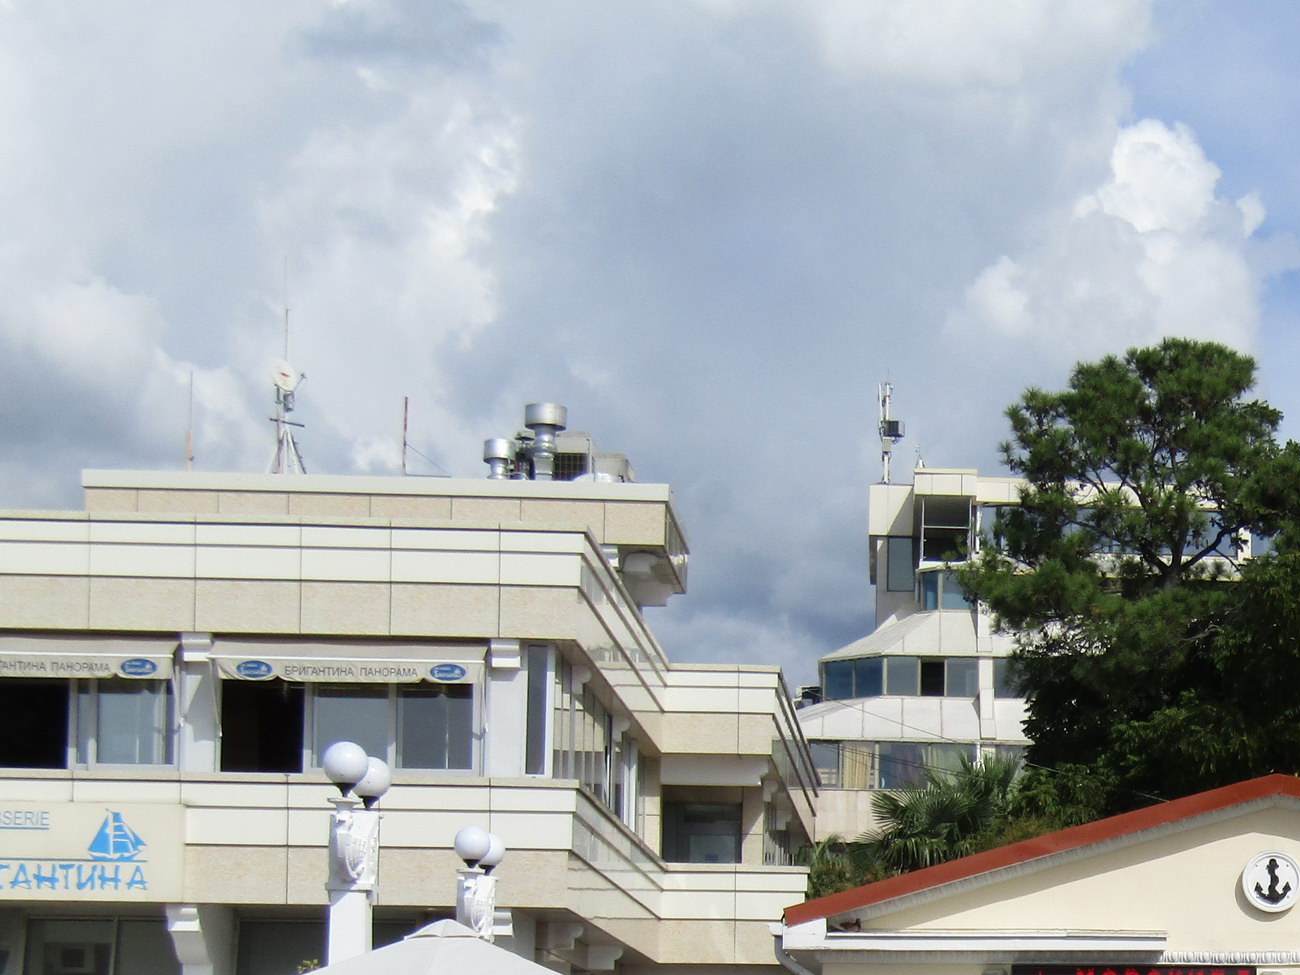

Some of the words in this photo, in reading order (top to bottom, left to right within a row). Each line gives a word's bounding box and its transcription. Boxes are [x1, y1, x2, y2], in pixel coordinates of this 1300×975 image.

[0, 660, 47, 672] АНТИНА
[52, 661, 111, 672] ПАНОРАМА
[284, 665, 354, 677] БРИГАНТИНА
[360, 666, 418, 678] ПАНОРАМА
[0, 811, 50, 826] SERIE
